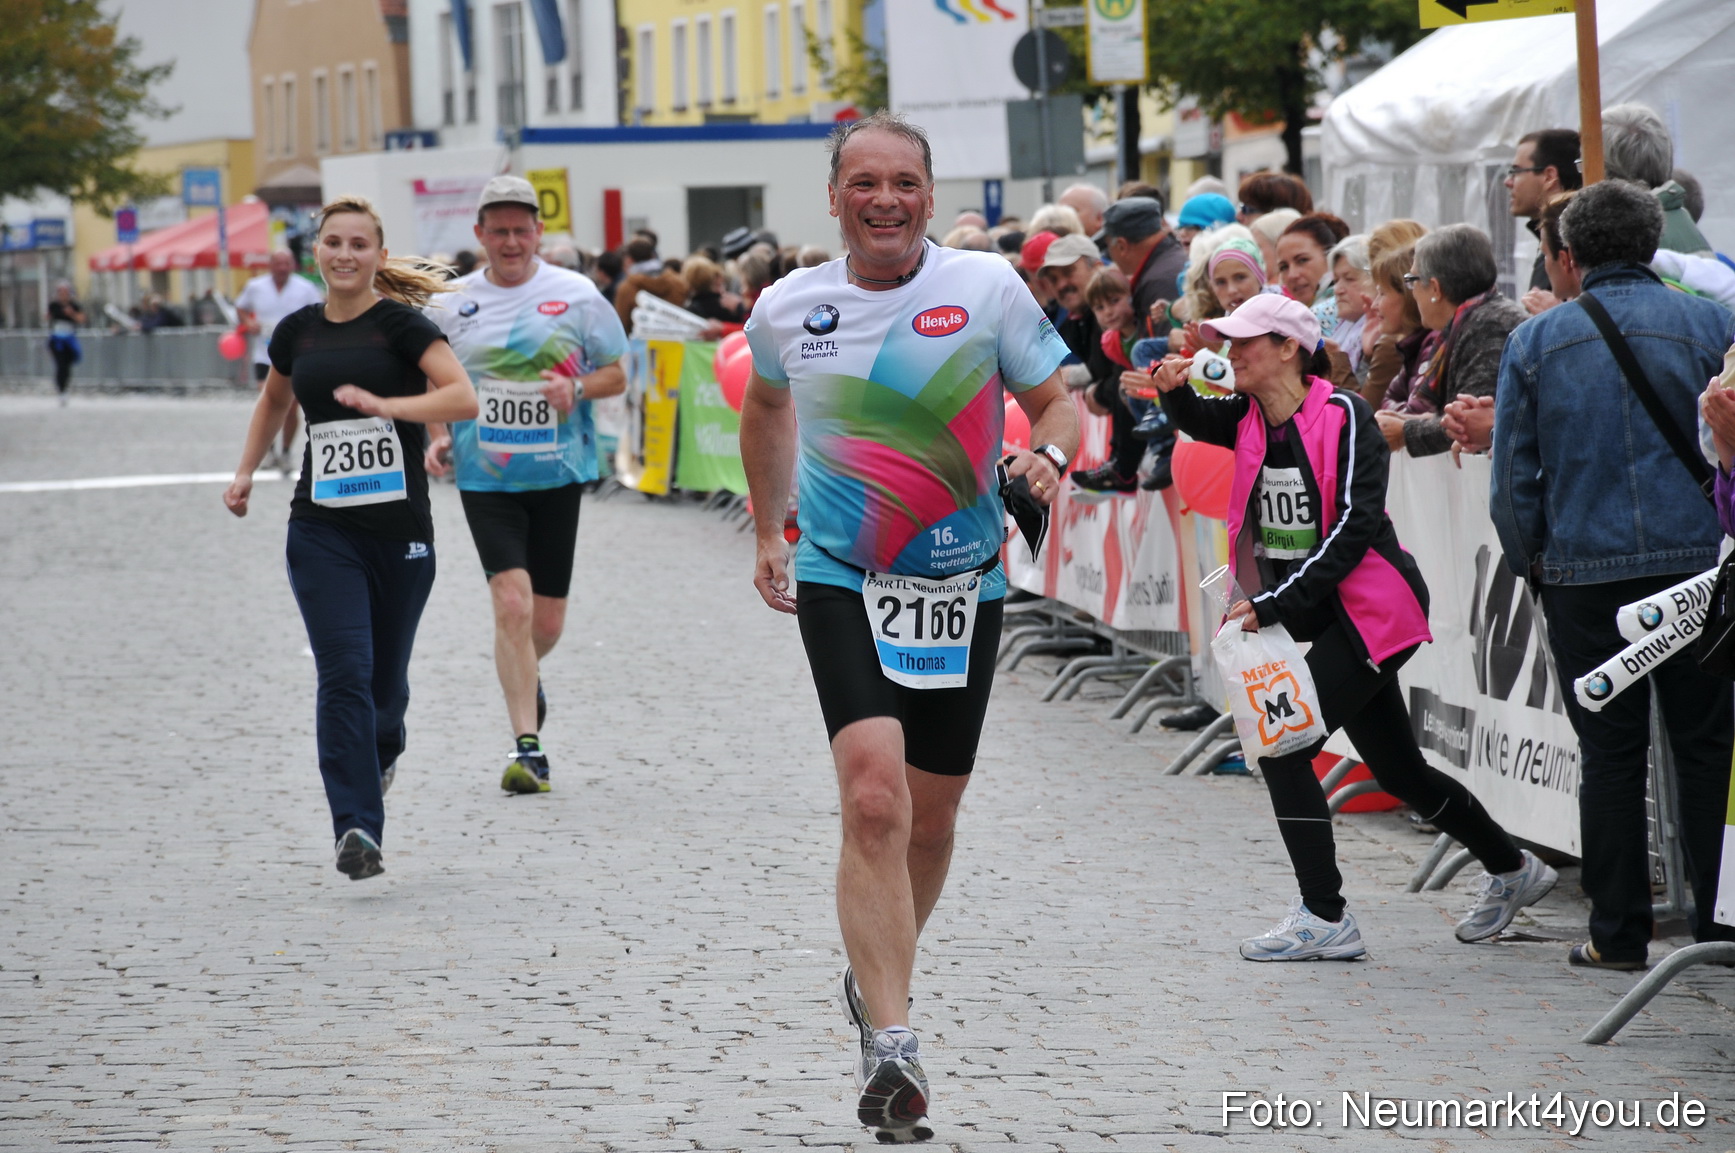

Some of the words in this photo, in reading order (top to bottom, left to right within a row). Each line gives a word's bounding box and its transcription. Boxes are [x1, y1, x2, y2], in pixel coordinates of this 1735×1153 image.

[539, 188, 561, 219] D
[808, 305, 838, 318] BMW
[920, 312, 963, 329] Hervis
[801, 340, 839, 353] PARTL
[801, 350, 838, 361] Neumarkt
[506, 388, 541, 397] Neumark
[486, 397, 550, 425] 3068
[312, 430, 340, 442] PARTL
[341, 426, 385, 438] Neumarkt
[487, 427, 548, 443] JOACHIM
[322, 437, 394, 475] 2366
[337, 478, 381, 494] Jasmin
[930, 526, 959, 547] 16.
[1267, 532, 1295, 549] Birgit
[930, 540, 982, 559] Neumarkter
[929, 553, 974, 570] Stadtlauf
[866, 578, 911, 591] PARTL
[912, 582, 966, 594] Neumarkt
[877, 595, 967, 641] 2166
[1620, 607, 1709, 676] bmw-lau
[896, 652, 946, 671] Thomas
[1264, 691, 1295, 725] M
